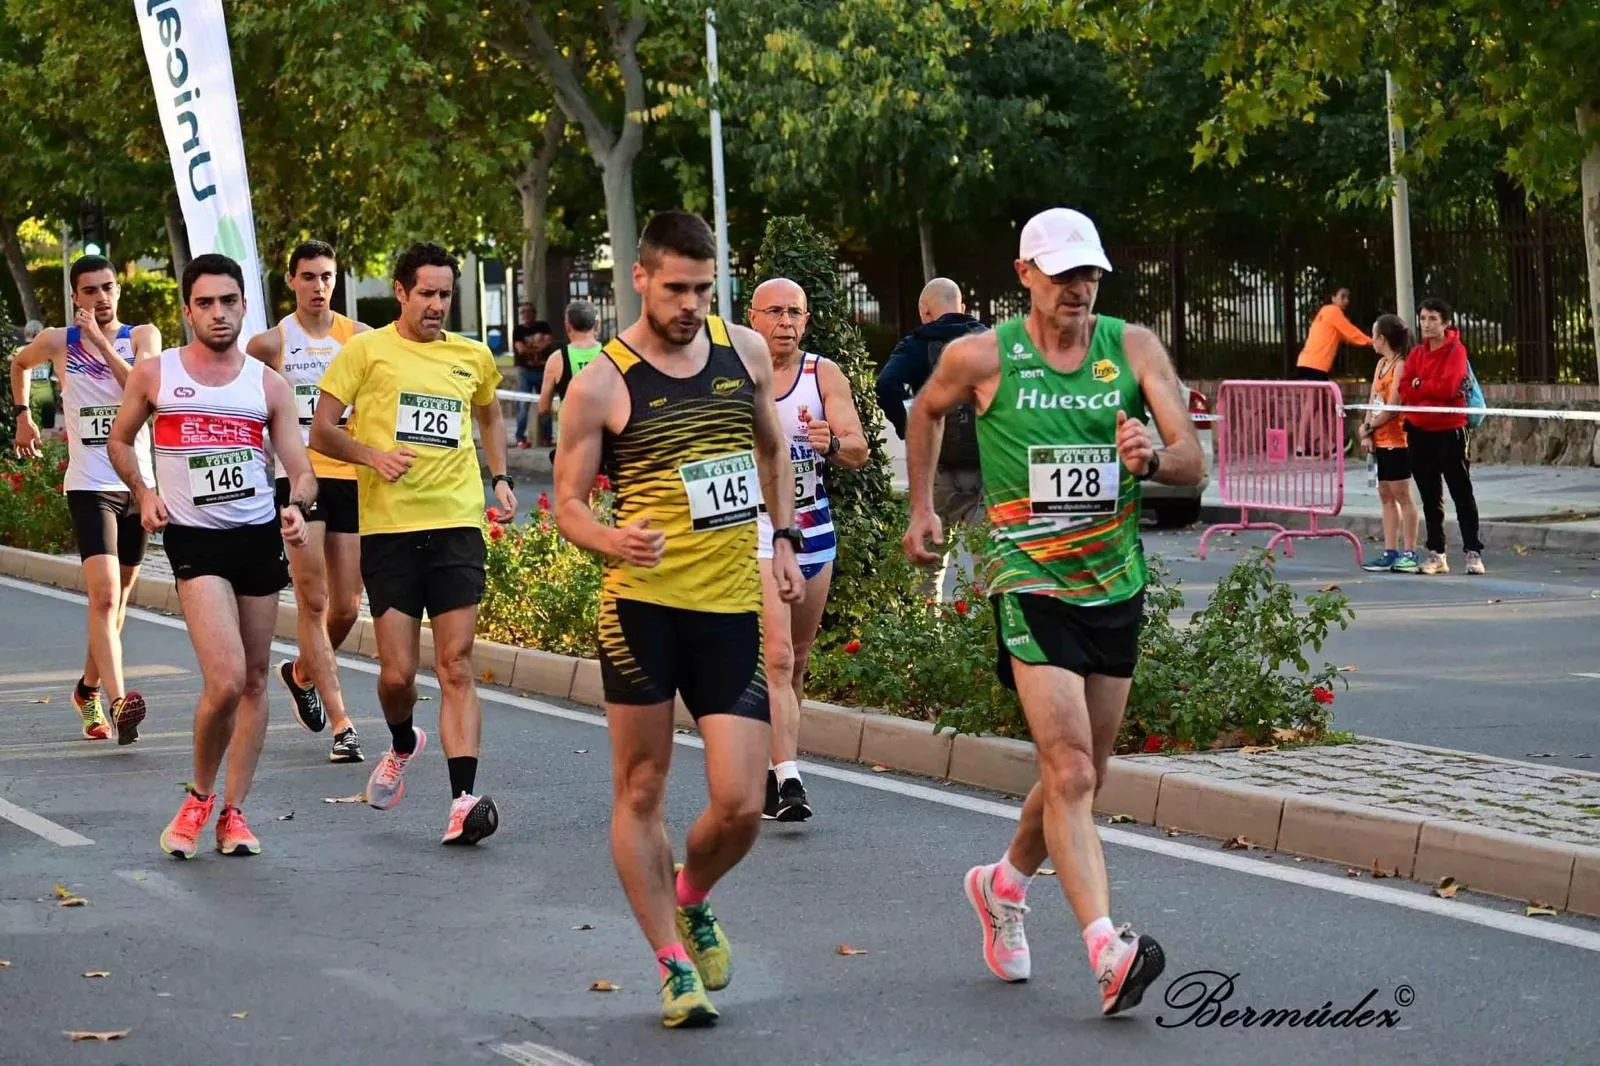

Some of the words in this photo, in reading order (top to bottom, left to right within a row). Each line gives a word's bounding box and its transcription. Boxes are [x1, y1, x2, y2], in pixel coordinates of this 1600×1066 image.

[417, 401, 457, 411] TOLEDO
[1016, 388, 1120, 409] Huesca
[91, 417, 116, 436] 15
[181, 422, 252, 437] ELCHE
[412, 410, 448, 435] 126
[206, 454, 249, 467] TOLEDO
[1055, 454, 1111, 463] TOLEDO
[205, 466, 244, 492] 146
[704, 462, 752, 477] TOLEDO
[1050, 467, 1100, 497] 128
[707, 475, 749, 511] 145
